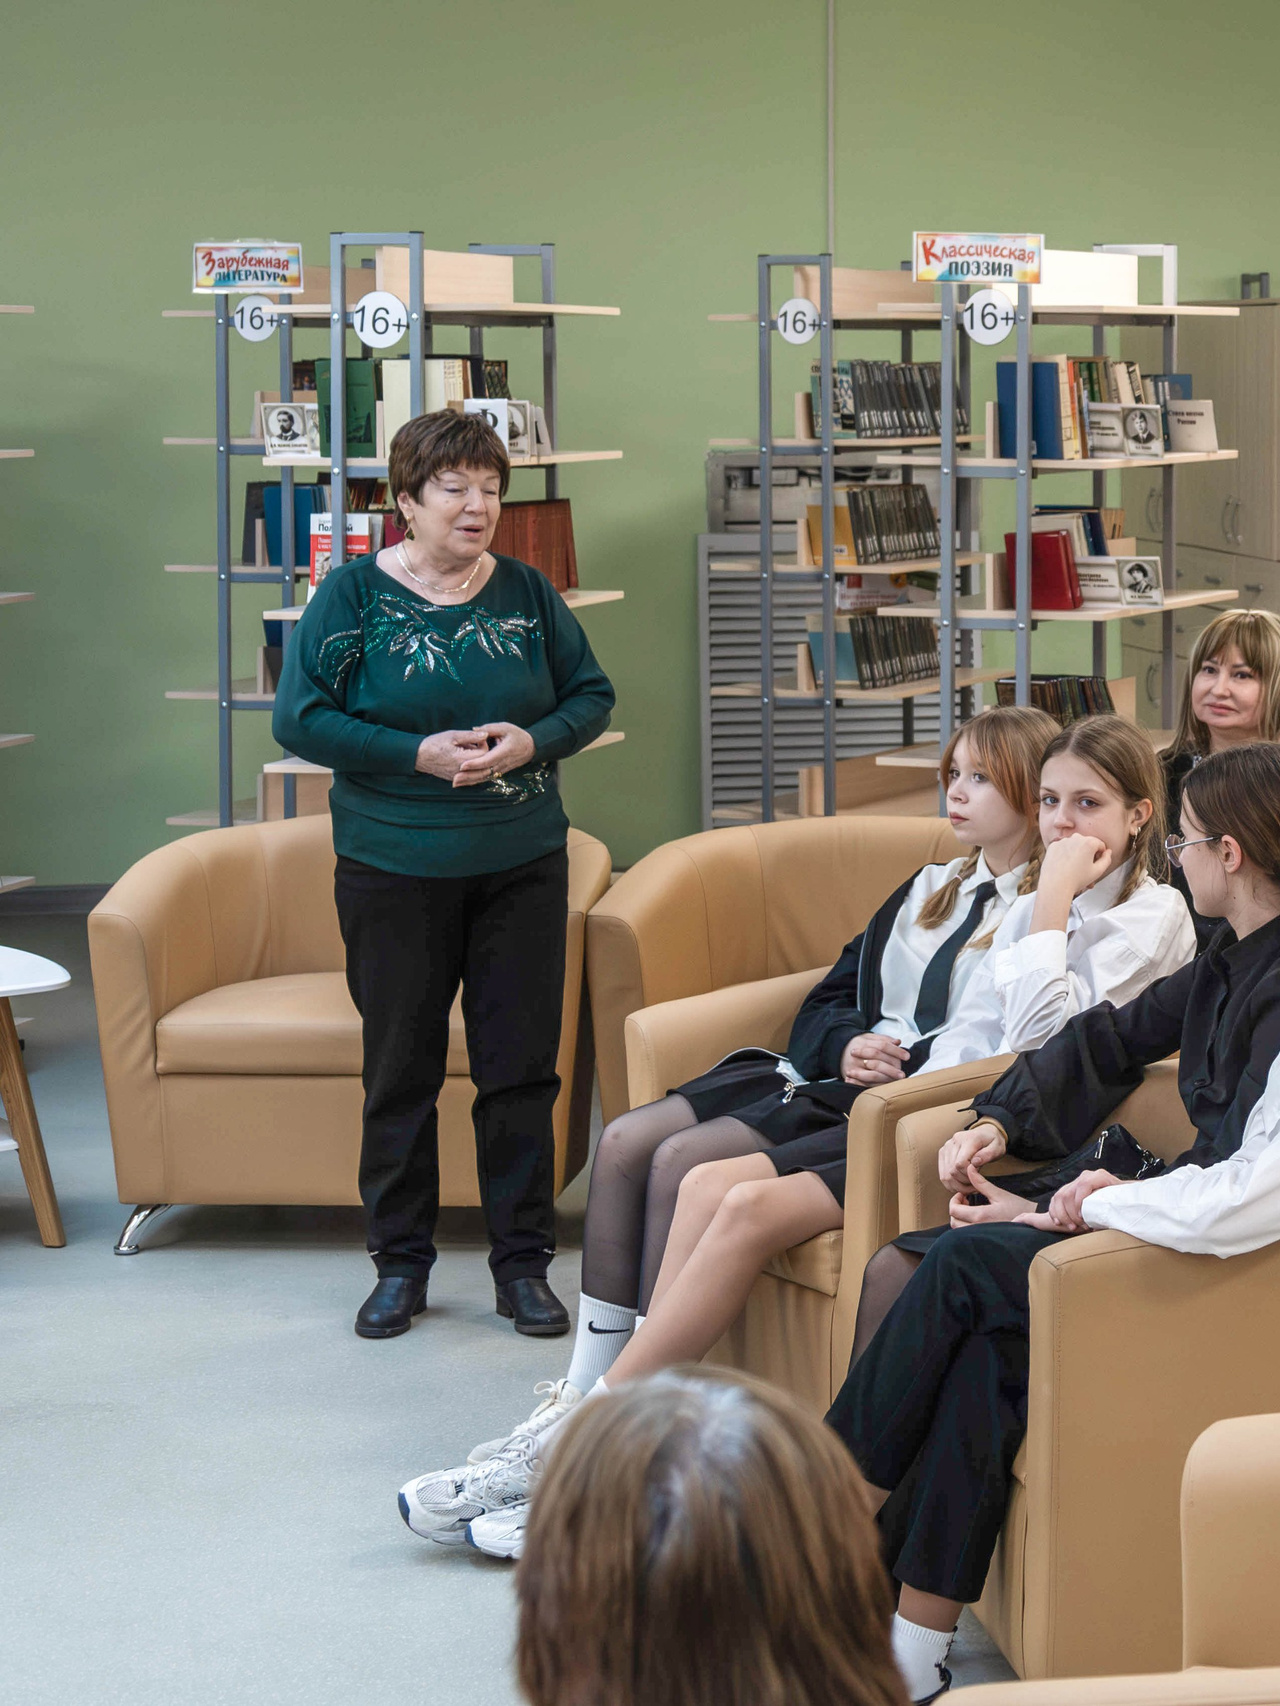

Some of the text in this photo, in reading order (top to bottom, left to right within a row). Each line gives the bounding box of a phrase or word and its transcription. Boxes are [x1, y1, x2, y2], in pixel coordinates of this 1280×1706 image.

[202, 249, 290, 276] Зарубежная
[922, 239, 1036, 266] Классическая
[215, 269, 288, 283] ЛИТЕРАТУРА
[948, 260, 1013, 277] ПОЭЗИЯ
[235, 306, 279, 331] 16+
[354, 305, 407, 335] 16+
[779, 310, 820, 334] 16+
[964, 302, 1014, 331] 16+
